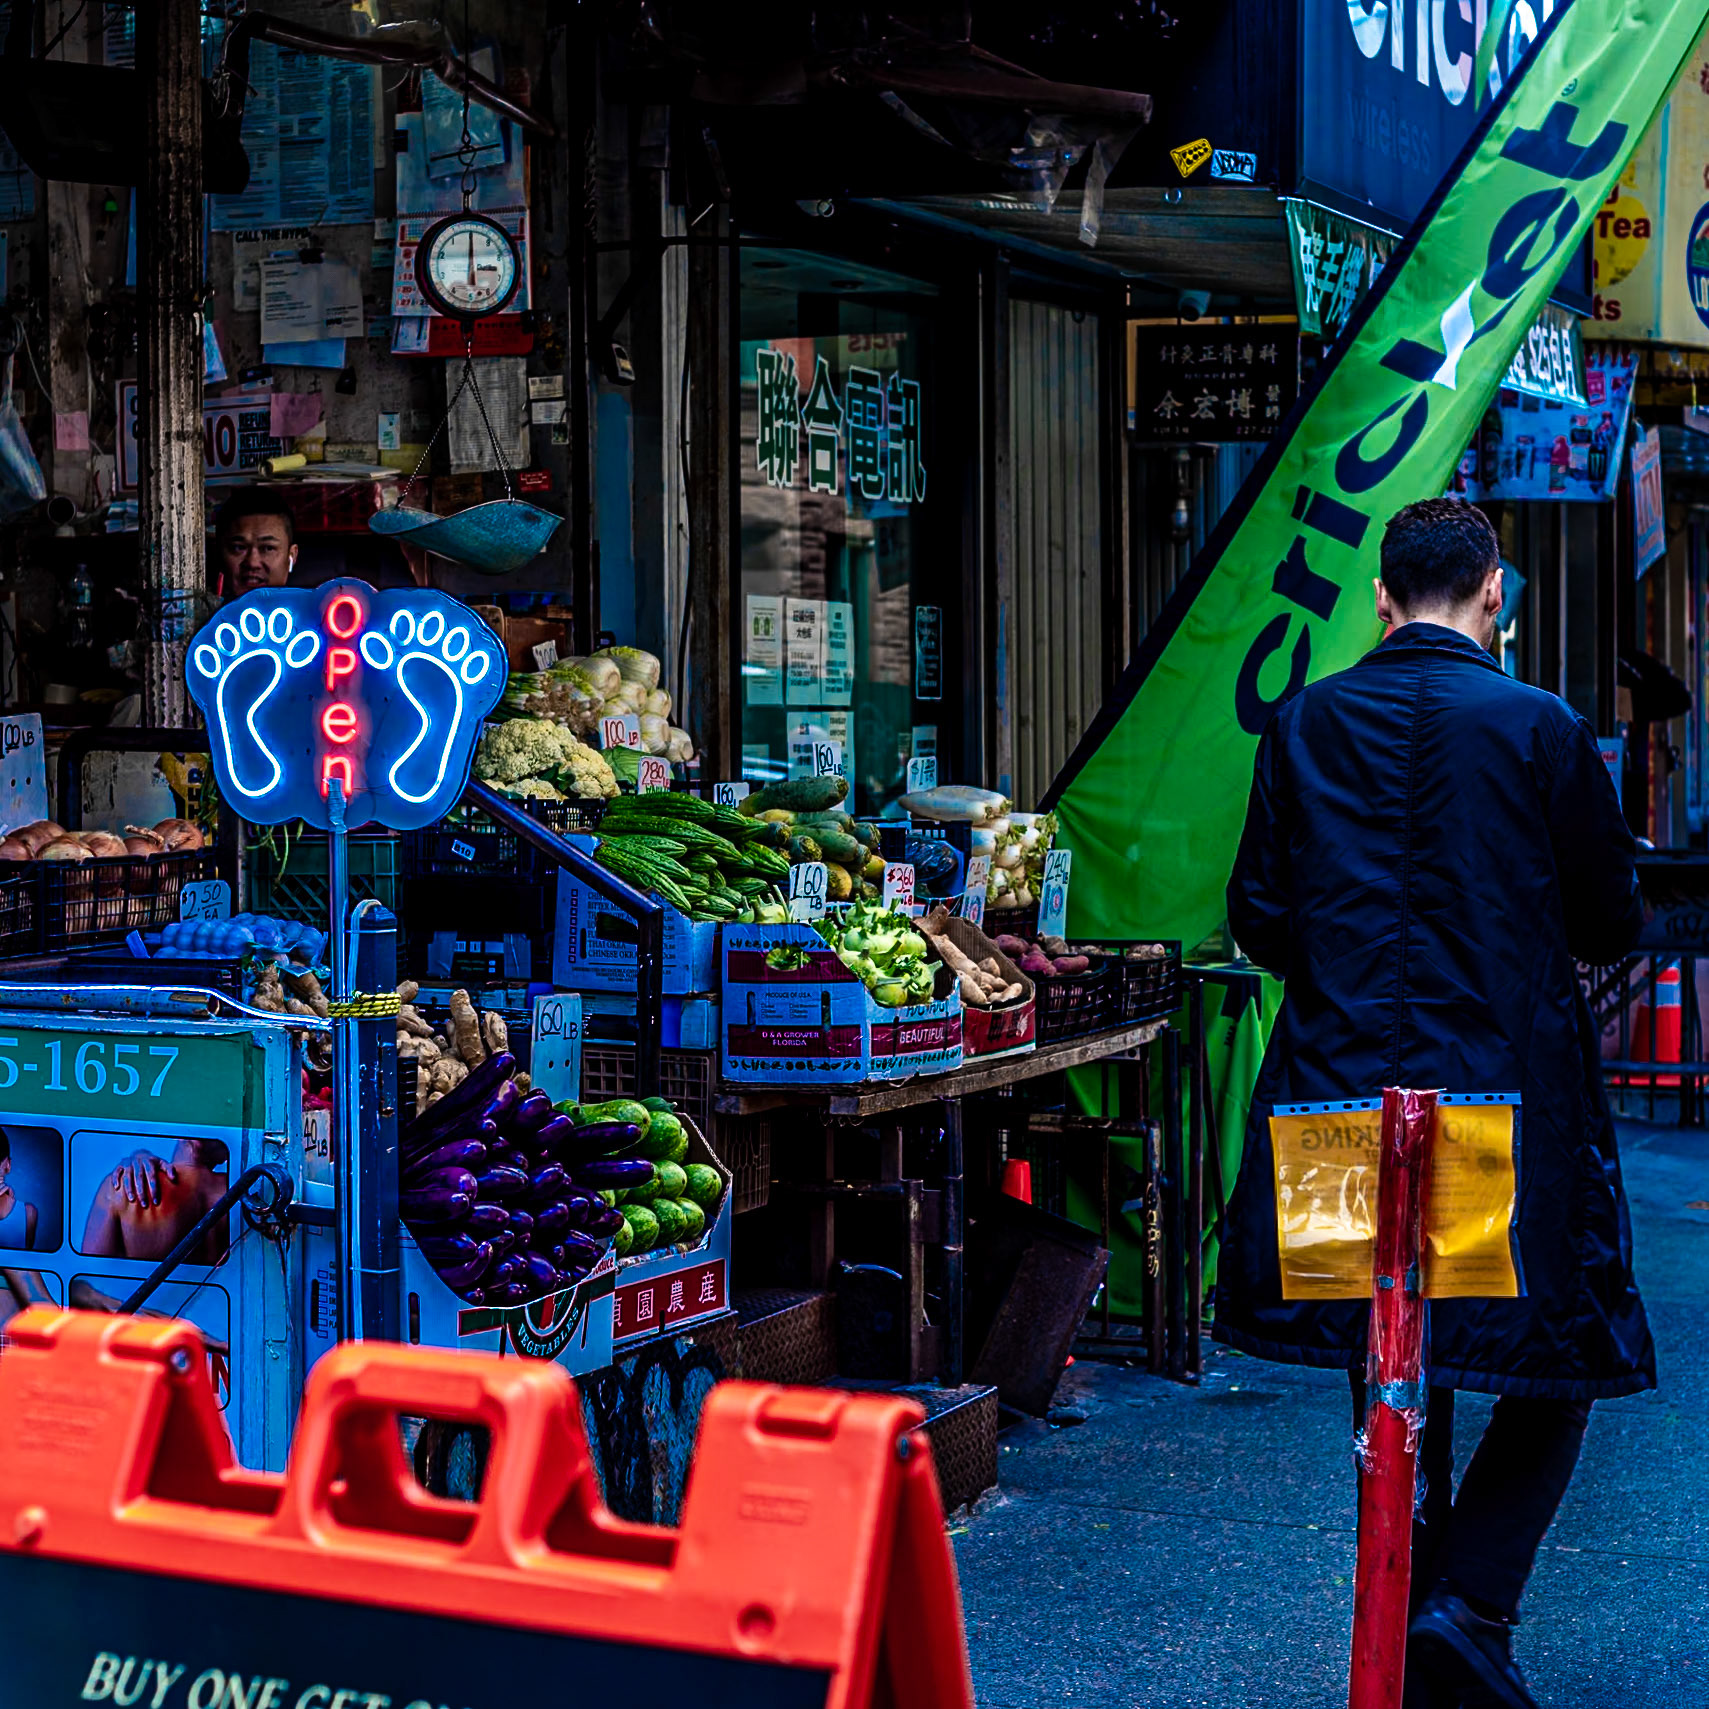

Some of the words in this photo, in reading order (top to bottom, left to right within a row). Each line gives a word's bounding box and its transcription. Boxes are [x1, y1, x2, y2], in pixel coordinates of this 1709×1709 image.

[1346, 85, 1431, 176] wireless
[1597, 211, 1651, 240] Tea
[236, 230, 259, 243] CALL
[261, 229, 279, 241] THE
[239, 411, 271, 427] REFUN
[756, 348, 926, 503] 聯合電訊
[22, 730, 35, 747] LB
[628, 731, 639, 746] LB
[454, 842, 473, 857] B10
[809, 897, 823, 910] LB
[606, 941, 626, 950] OKRA
[588, 950, 618, 959] CHINESE
[766, 991, 789, 999] PRODUCE
[790, 991, 798, 999] OF
[563, 1021, 578, 1041] LB
[783, 1031, 819, 1039] GROWER
[900, 1027, 946, 1045] BEAUTIFUL
[317, 1138, 328, 1158] LB
[517, 1307, 579, 1356] VEGETABLES
[80, 1651, 188, 1709] BUY
[188, 1668, 290, 1709] ONE
